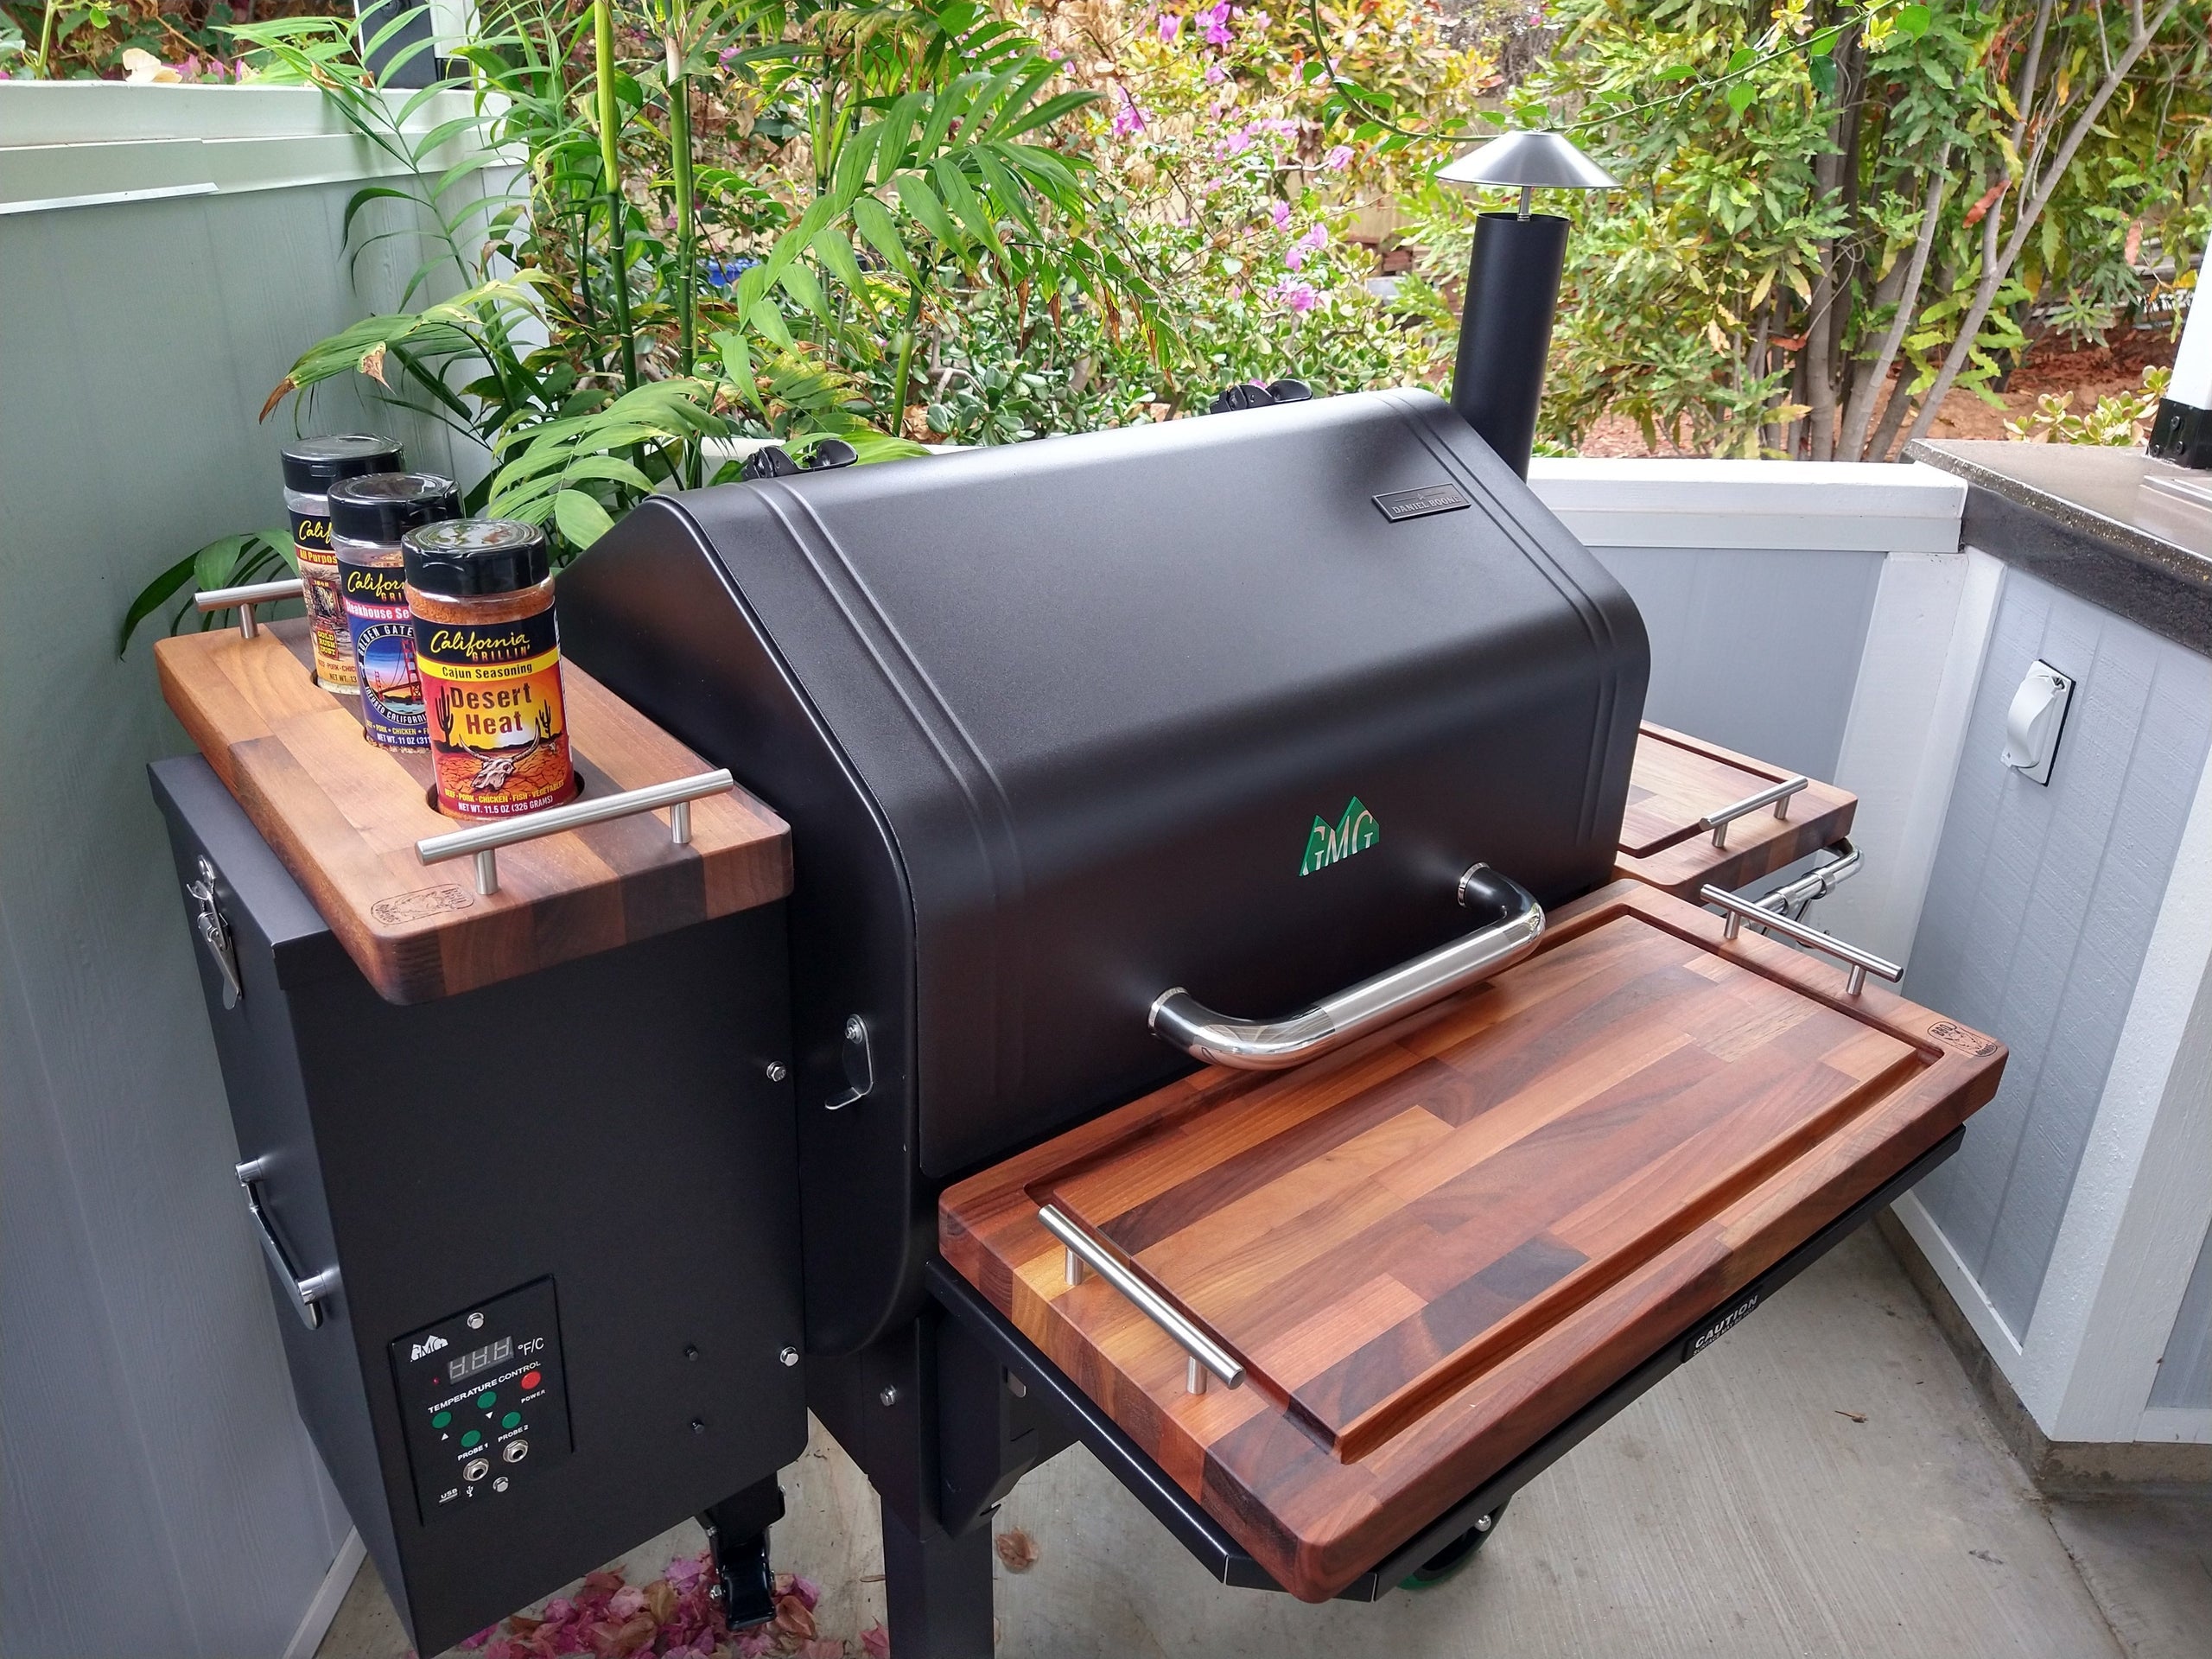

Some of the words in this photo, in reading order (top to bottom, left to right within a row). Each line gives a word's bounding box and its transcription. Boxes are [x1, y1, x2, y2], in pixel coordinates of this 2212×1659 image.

[1392, 500, 1428, 513] DANIEL
[1429, 496, 1461, 507] BOONE
[317, 630, 334, 641] GOLD
[358, 627, 380, 656] GOLDEN
[384, 625, 413, 637] GATE
[430, 630, 530, 658] California
[472, 644, 530, 662] GRILLIN'
[442, 665, 472, 679] Cajun
[475, 663, 532, 679] Seasoning
[365, 686, 385, 714] INFUSED
[450, 683, 532, 709] Desert
[465, 711, 523, 734] Heat
[377, 733, 385, 742] NET
[444, 788, 455, 798] BEEF
[459, 793, 474, 803] PORK
[513, 792, 528, 802] FISH
[531, 779, 564, 798] VEGETABLES
[458, 802, 470, 811] NET
[471, 804, 483, 813] WT.
[484, 805, 499, 814] 11.5
[512, 802, 528, 812] (326
[530, 794, 553, 809] GRAMS)
[1300, 808, 1376, 877] GMG
[1695, 1295, 1758, 1348] CAUTION
[428, 1379, 498, 1414] TEMPERATURE
[499, 1360, 541, 1383] CONTROL
[520, 1389, 546, 1404] POWER
[498, 1427, 523, 1442] PROBE
[457, 1445, 484, 1461] PROBE
[441, 1488, 459, 1499] USB
